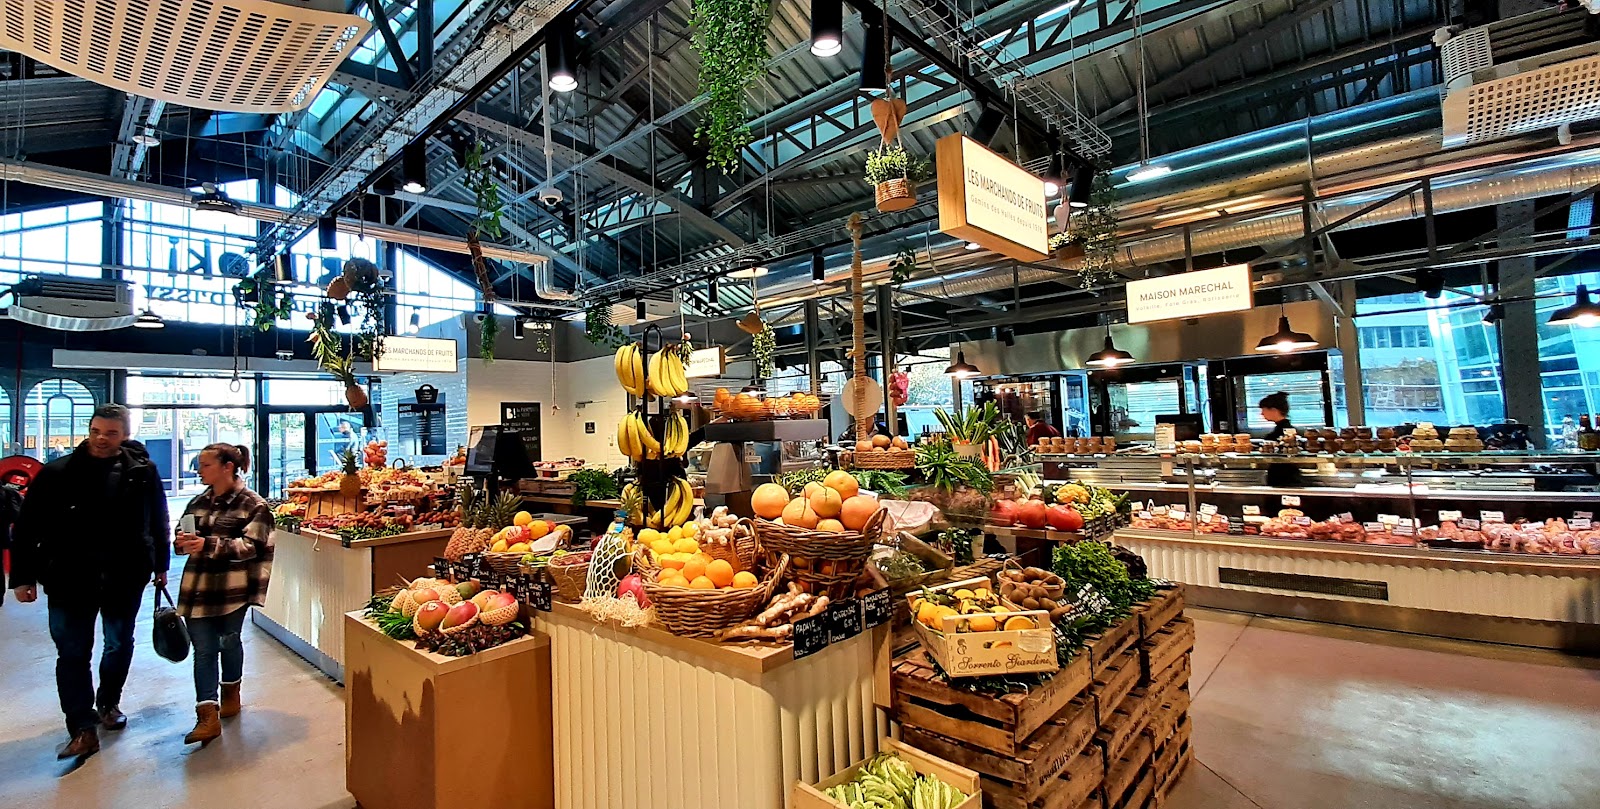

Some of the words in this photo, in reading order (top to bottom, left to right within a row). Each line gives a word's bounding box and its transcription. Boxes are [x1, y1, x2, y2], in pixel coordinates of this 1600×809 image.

[967, 166, 979, 187] LES
[980, 173, 1017, 206] MARCHANDS
[1017, 193, 1025, 210] DE
[1025, 197, 1044, 219] FRUITS
[1139, 289, 1177, 302] MAISON
[1179, 281, 1234, 296] MARECHAL
[392, 347, 427, 356] MARCHANDS
[435, 349, 453, 357] FRUITS
[958, 656, 1002, 670] Sorrento
[1005, 653, 1050, 670] Giardini
